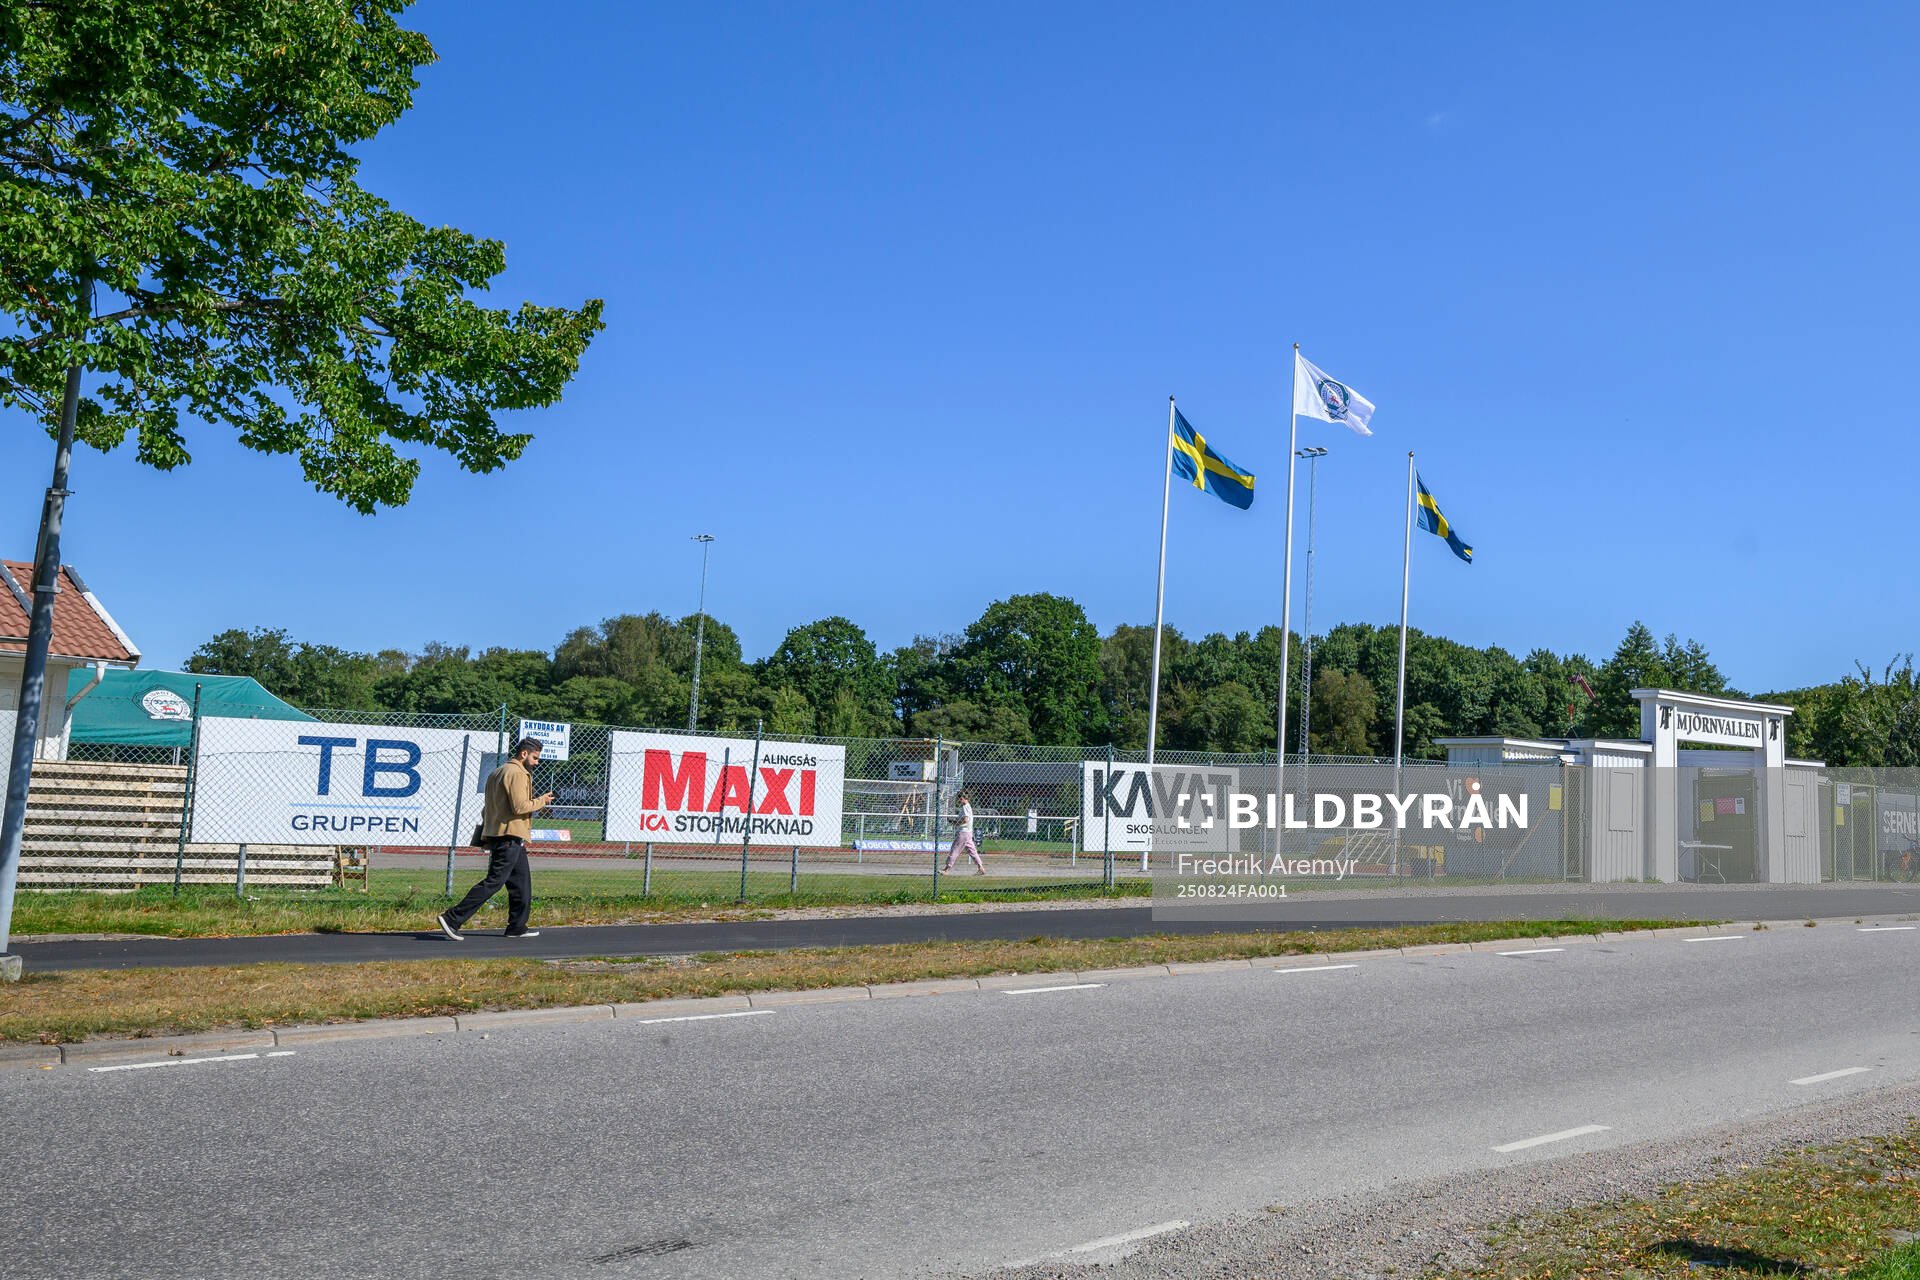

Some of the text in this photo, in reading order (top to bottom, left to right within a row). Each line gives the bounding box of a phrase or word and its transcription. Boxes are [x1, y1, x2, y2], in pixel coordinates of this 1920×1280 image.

[524, 721, 565, 732] SKYDDAS AV
[1677, 712, 1760, 739] MJÖRNVALLEN
[297, 735, 422, 798] TB
[763, 753, 817, 767] ALINGSÅS
[641, 748, 817, 817] MAXI
[1092, 769, 1233, 820] KAVAT
[291, 815, 419, 833] GRUPPEN
[640, 813, 813, 836] ICA STORMARKNAD
[1126, 824, 1208, 835] SKOSALONGEN
